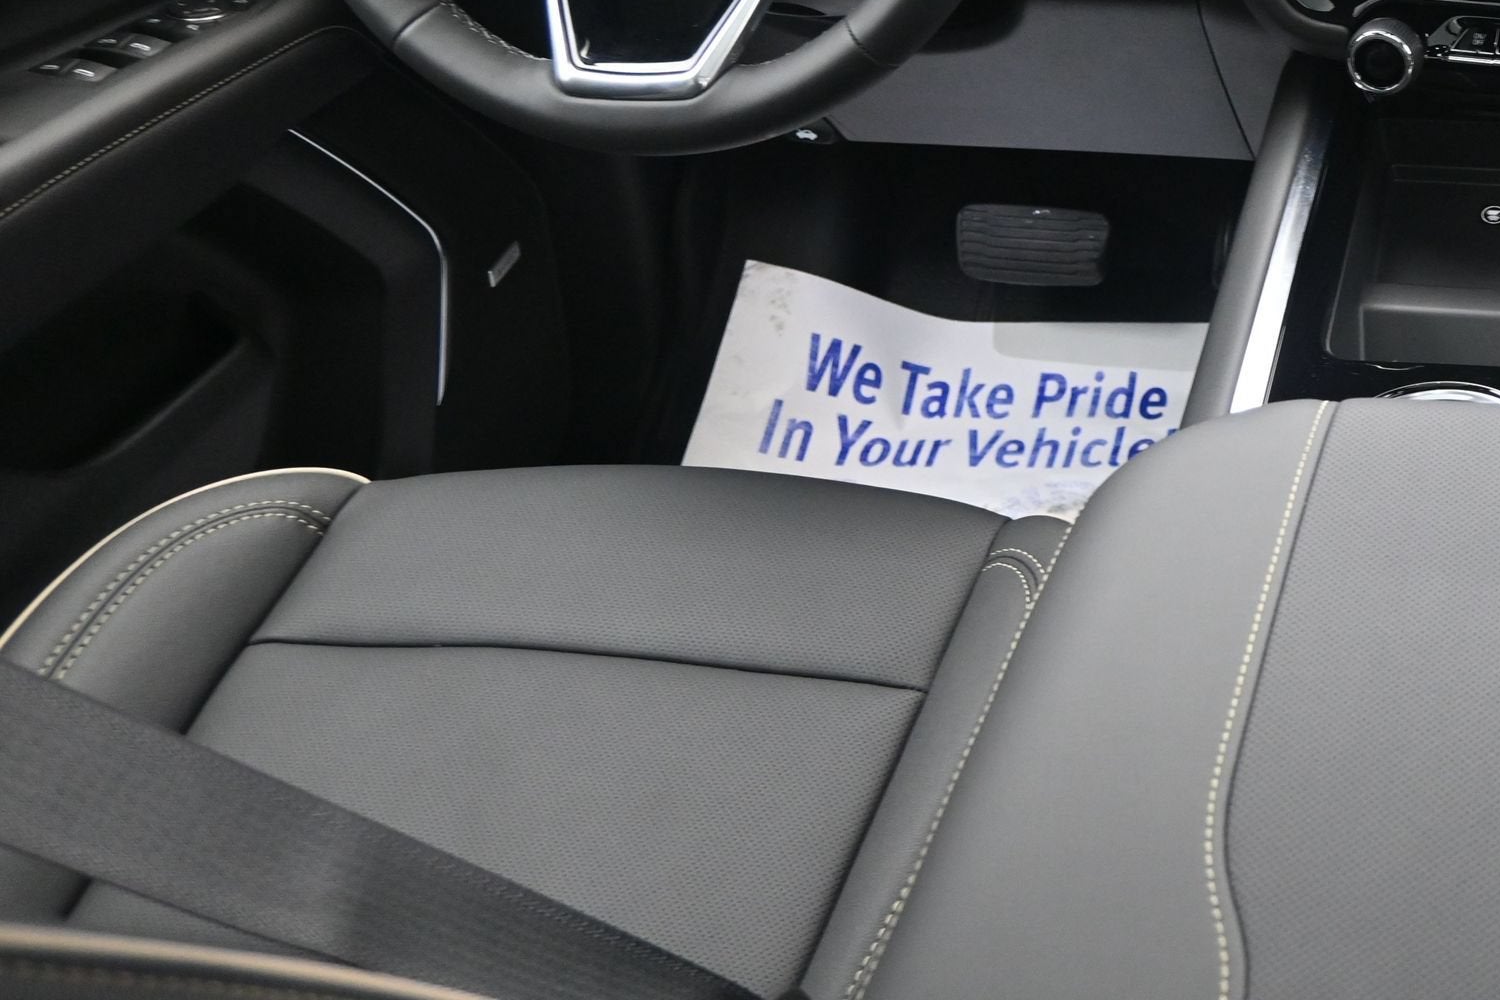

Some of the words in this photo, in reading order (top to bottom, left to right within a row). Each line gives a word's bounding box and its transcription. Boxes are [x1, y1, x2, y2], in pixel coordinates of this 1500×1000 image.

[806, 332, 885, 406] We
[900, 359, 1016, 420] Take
[1032, 370, 1169, 420] Pride
[758, 398, 815, 462] In
[834, 413, 952, 467] Your
[968, 426, 1177, 468] Vehicle
